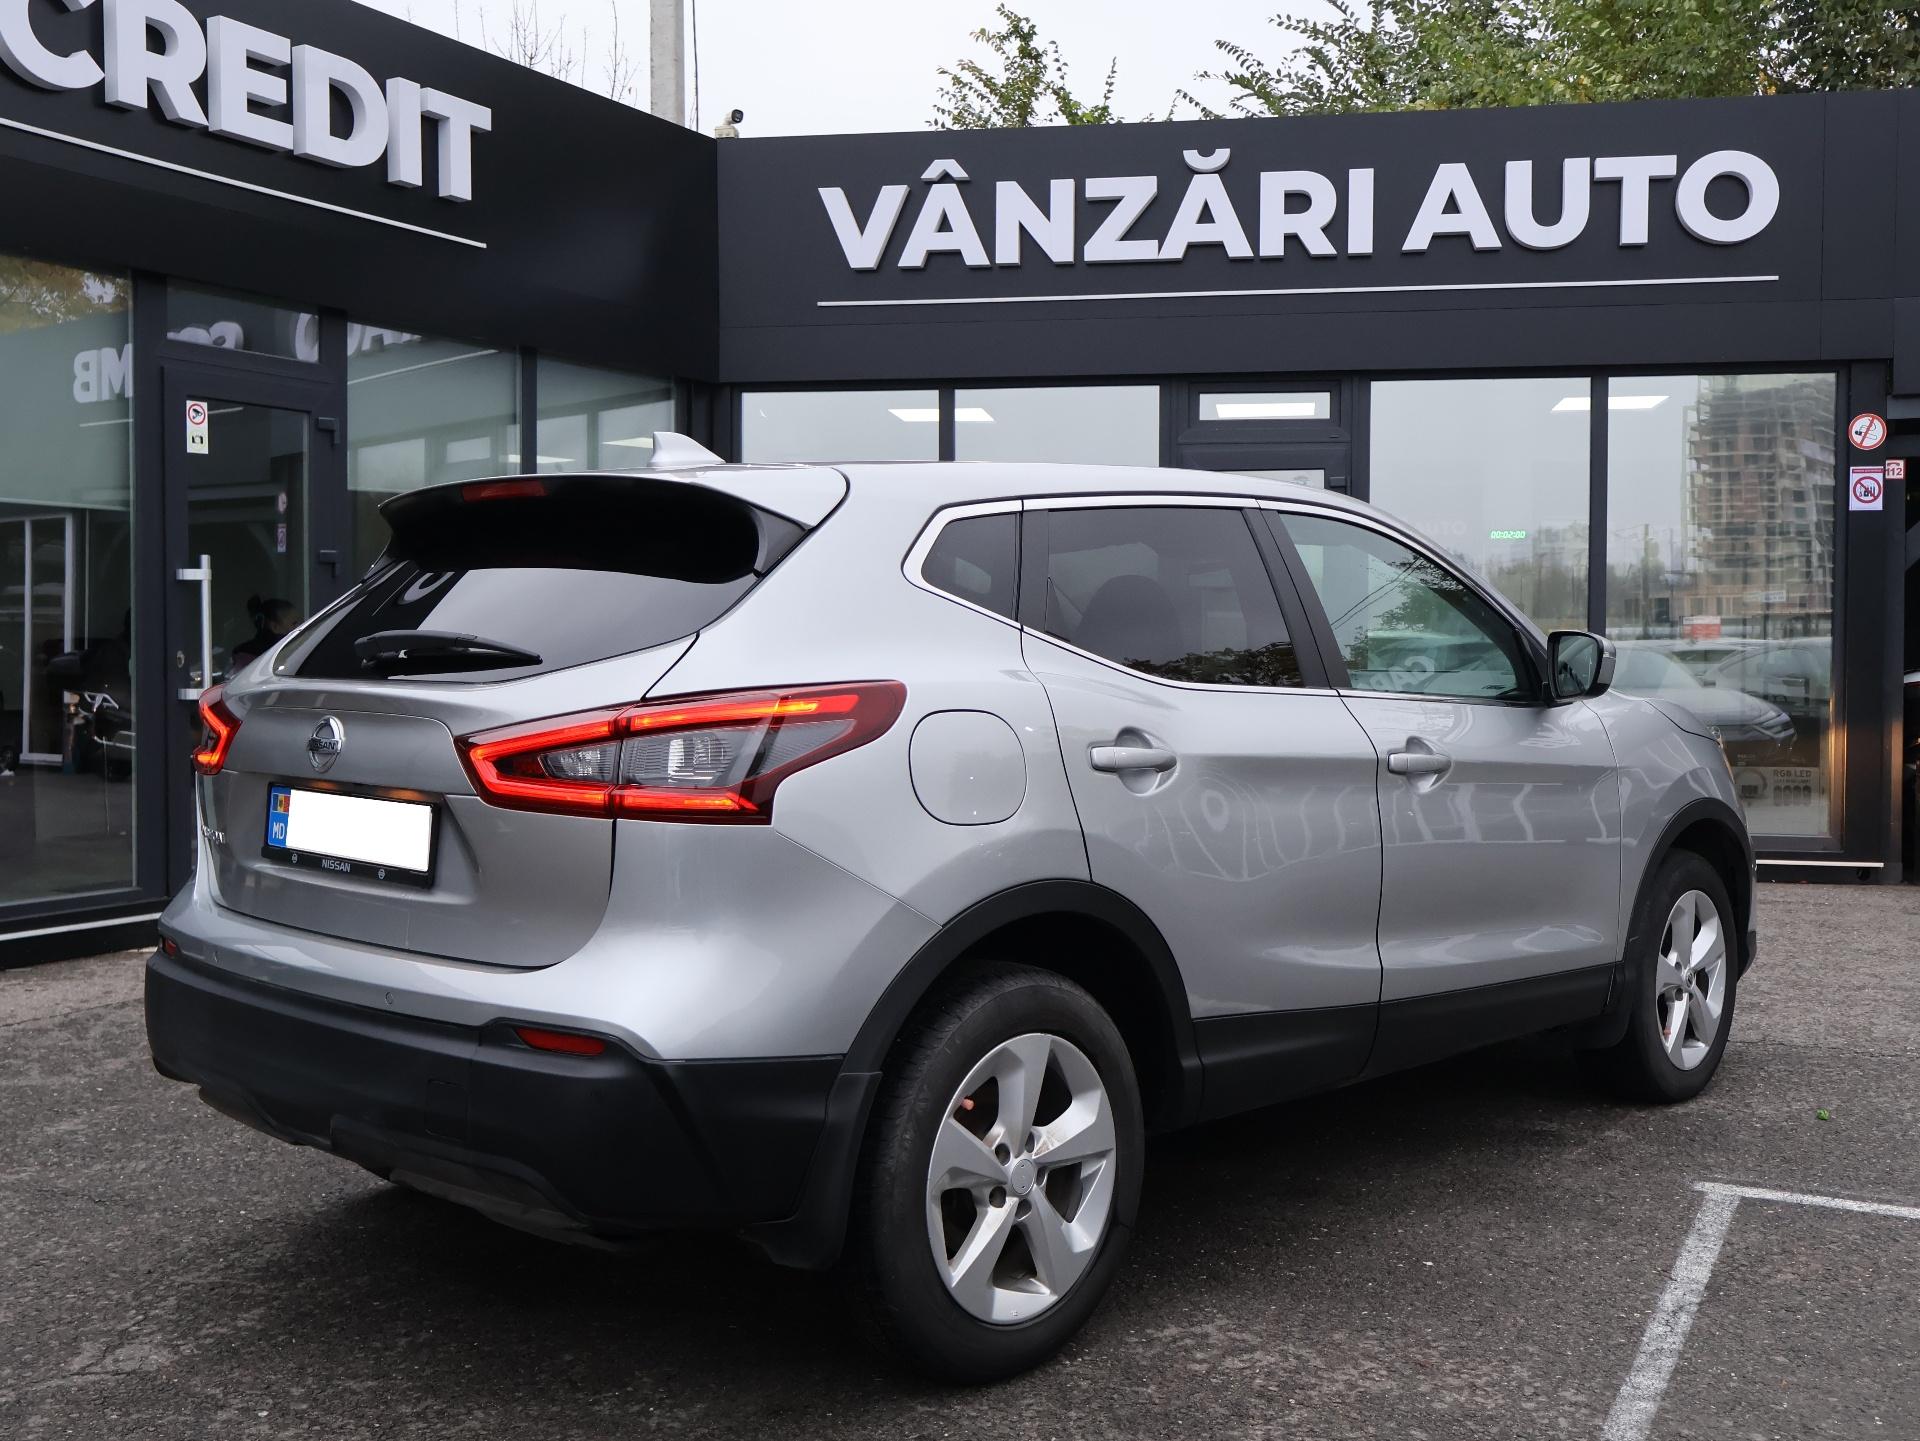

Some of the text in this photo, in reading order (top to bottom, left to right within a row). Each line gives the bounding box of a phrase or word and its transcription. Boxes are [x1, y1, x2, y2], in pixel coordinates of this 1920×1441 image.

[0, 0, 492, 202] CREDIT
[817, 148, 1780, 271] VÂNZĂRI AUTO
[1885, 467, 1903, 476] 112
[1773, 769, 1812, 778] RGB LED
[272, 822, 286, 840] MD
[321, 858, 351, 873] NISSAN
